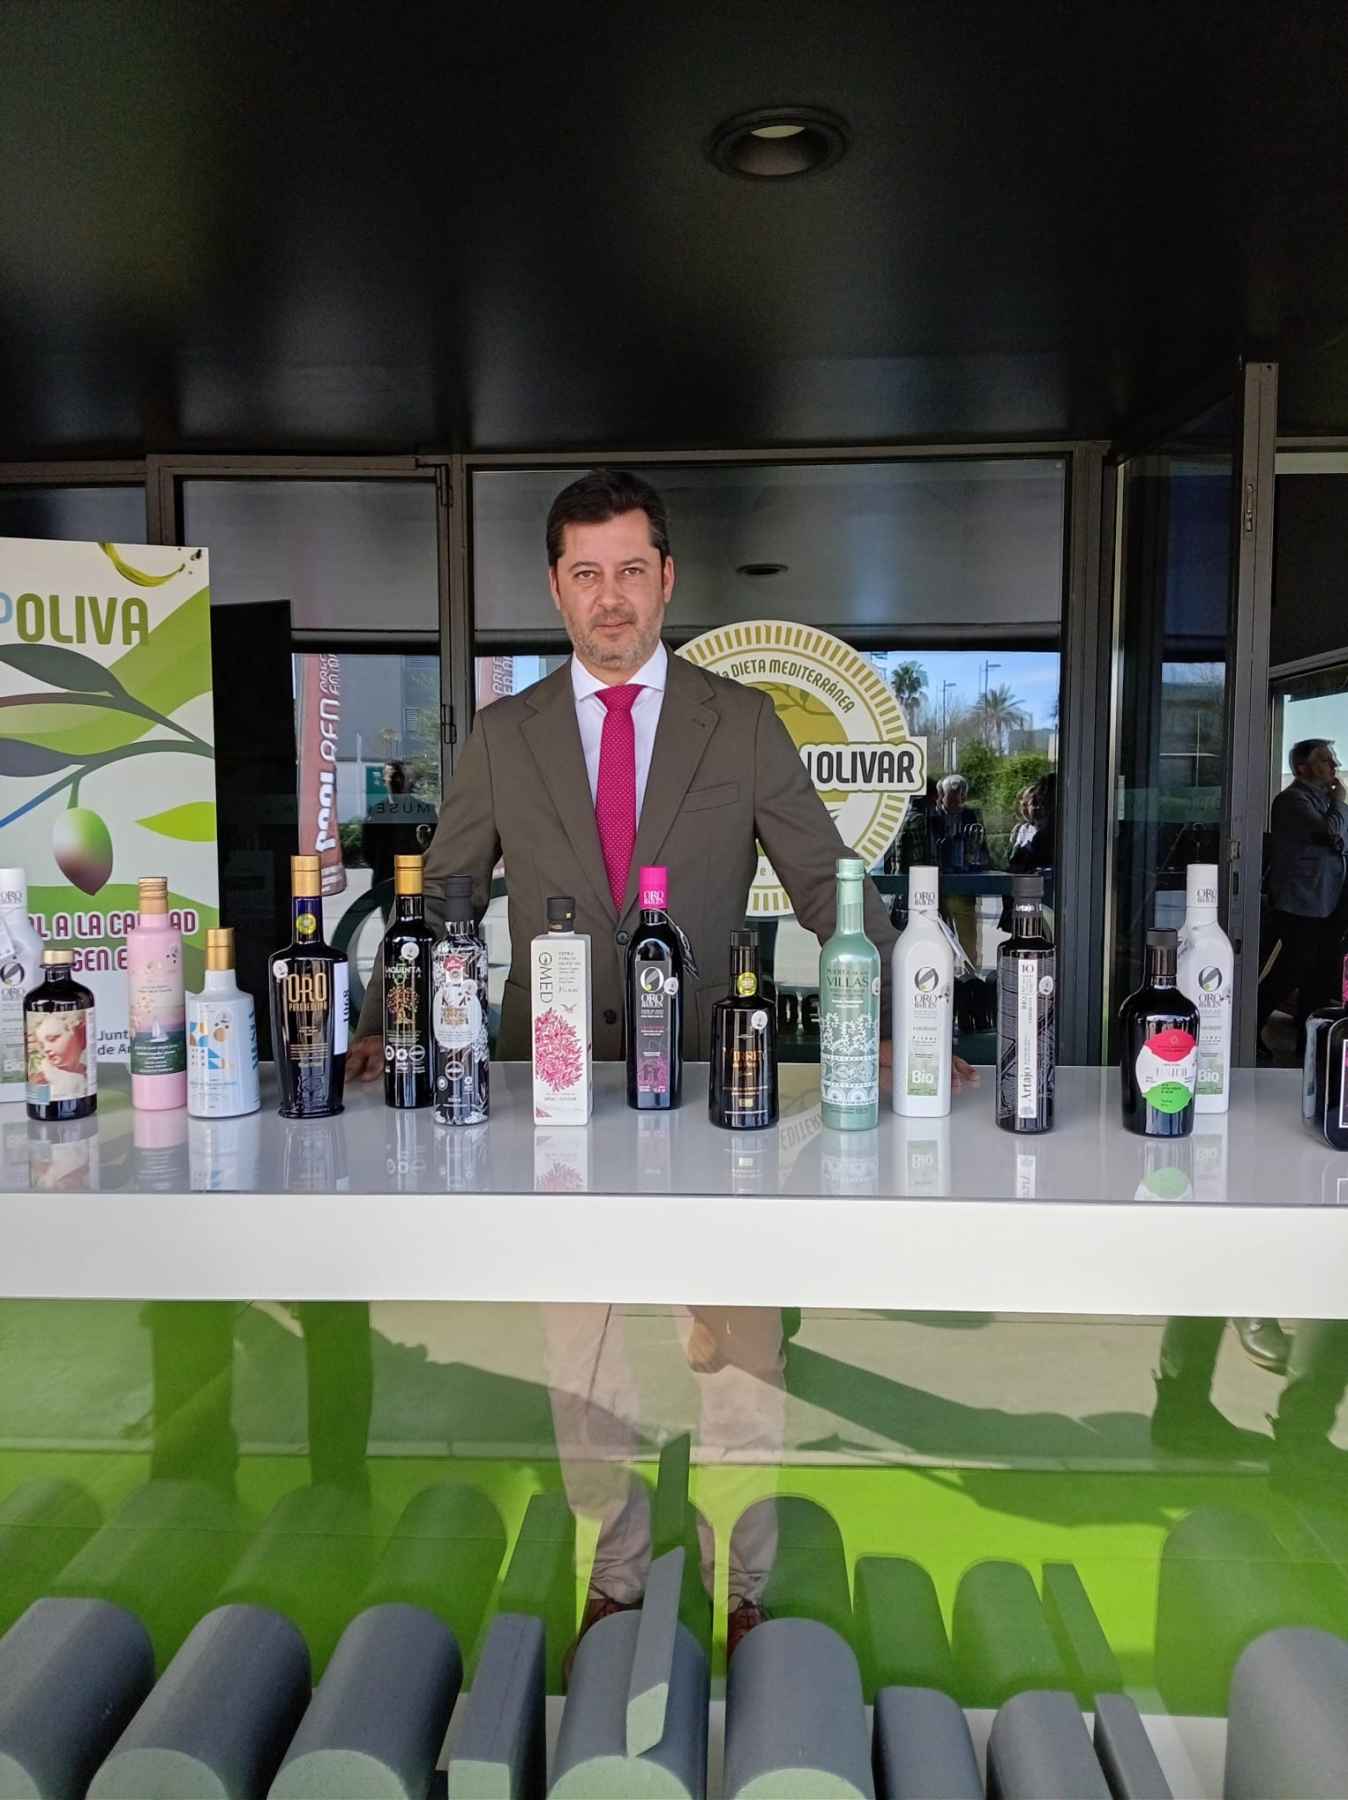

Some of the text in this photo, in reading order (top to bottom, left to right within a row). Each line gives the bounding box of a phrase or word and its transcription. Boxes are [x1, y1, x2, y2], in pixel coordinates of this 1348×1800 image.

[731, 659, 766, 678] DIETA
[769, 659, 856, 714] MEDITERRÁNEA
[56, 914, 69, 937] A
[77, 914, 102, 936] LA
[109, 911, 197, 935] CAAD
[287, 973, 327, 1002] ORO
[541, 952, 554, 1004] OMED
[826, 976, 869, 987] VILLAS
[97, 1030, 128, 1041] Junt
[97, 1045, 114, 1055] de
[912, 1070, 934, 1083] Bio
